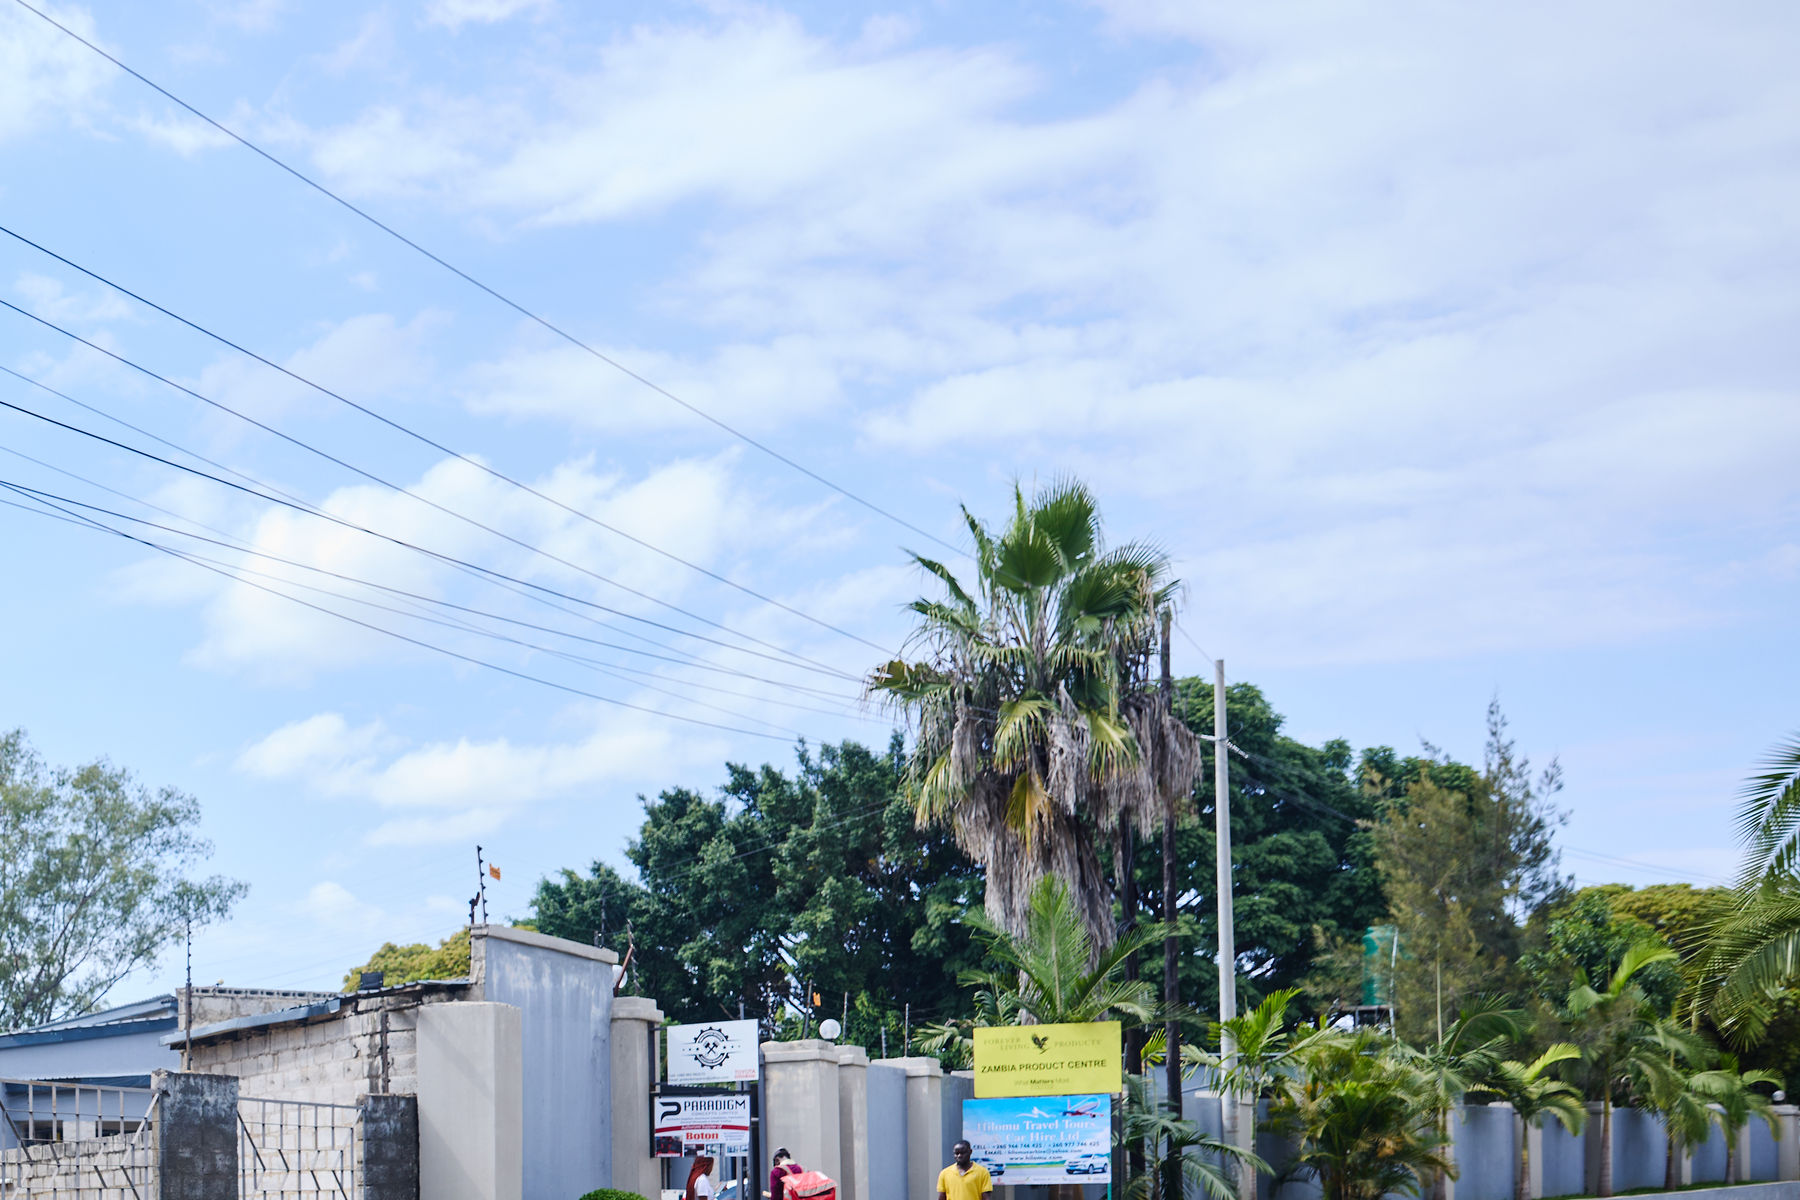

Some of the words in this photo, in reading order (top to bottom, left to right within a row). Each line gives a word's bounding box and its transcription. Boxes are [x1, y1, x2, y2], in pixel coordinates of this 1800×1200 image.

[984, 1037, 1021, 1045] FOREVER
[1054, 1038, 1102, 1048] PRODUCTS
[1000, 1043, 1030, 1051] LIVING
[981, 1064, 1017, 1074] ZAMBIA
[1019, 1061, 1064, 1072] PRODUCT
[1067, 1059, 1107, 1069] CENTRE
[684, 1099, 746, 1111] PARADIGM
[976, 1120, 1020, 1132] Hilomu
[1023, 1119, 1059, 1131] Travel
[1062, 1119, 1096, 1130] Tours
[686, 1132, 719, 1140] Boton
[1006, 1133, 1026, 1143] Car
[1030, 1132, 1057, 1142] Hire
[1060, 1131, 1080, 1141] Ltd
